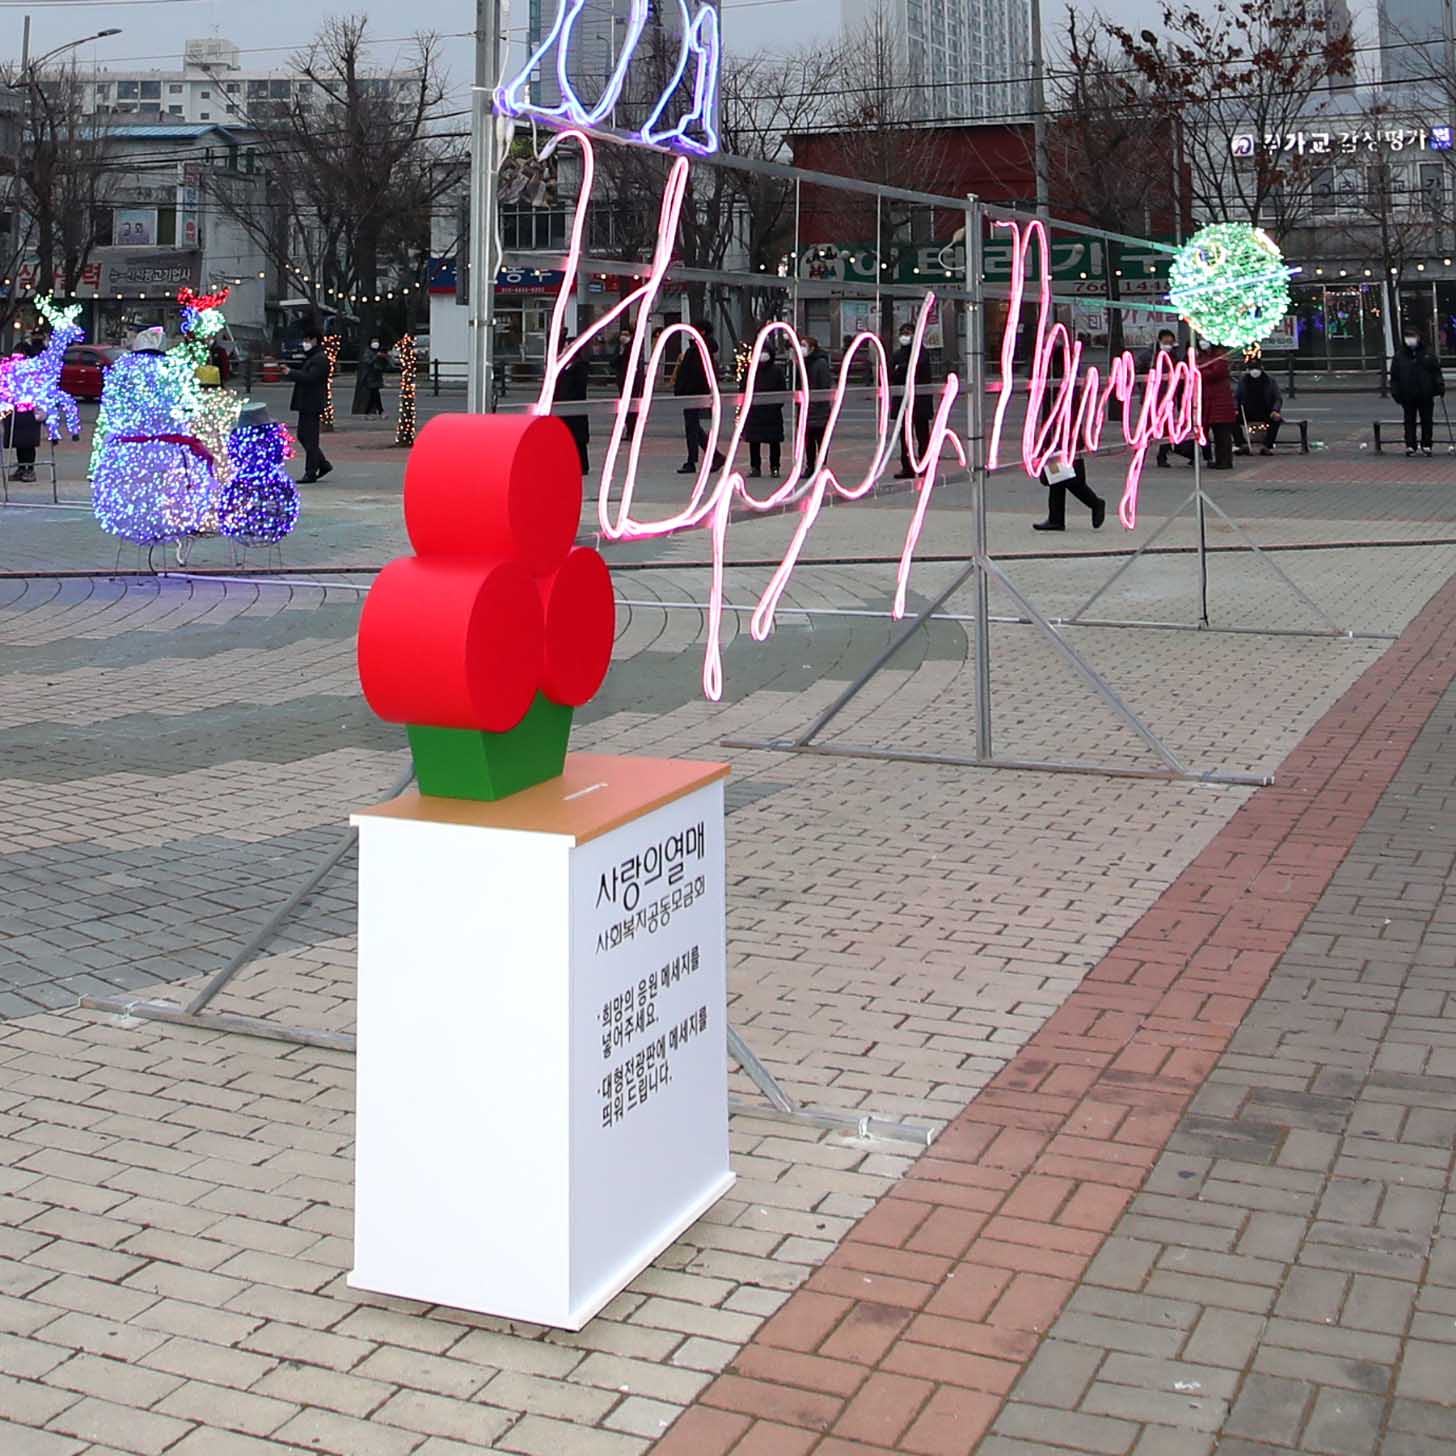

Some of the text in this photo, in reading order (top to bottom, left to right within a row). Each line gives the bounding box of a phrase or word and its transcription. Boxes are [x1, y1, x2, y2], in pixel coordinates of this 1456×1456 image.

[595, 821, 705, 912] 사랑의열매
[595, 874, 705, 955] 사회복지공동모금회
[637, 972, 658, 1008] 응원
